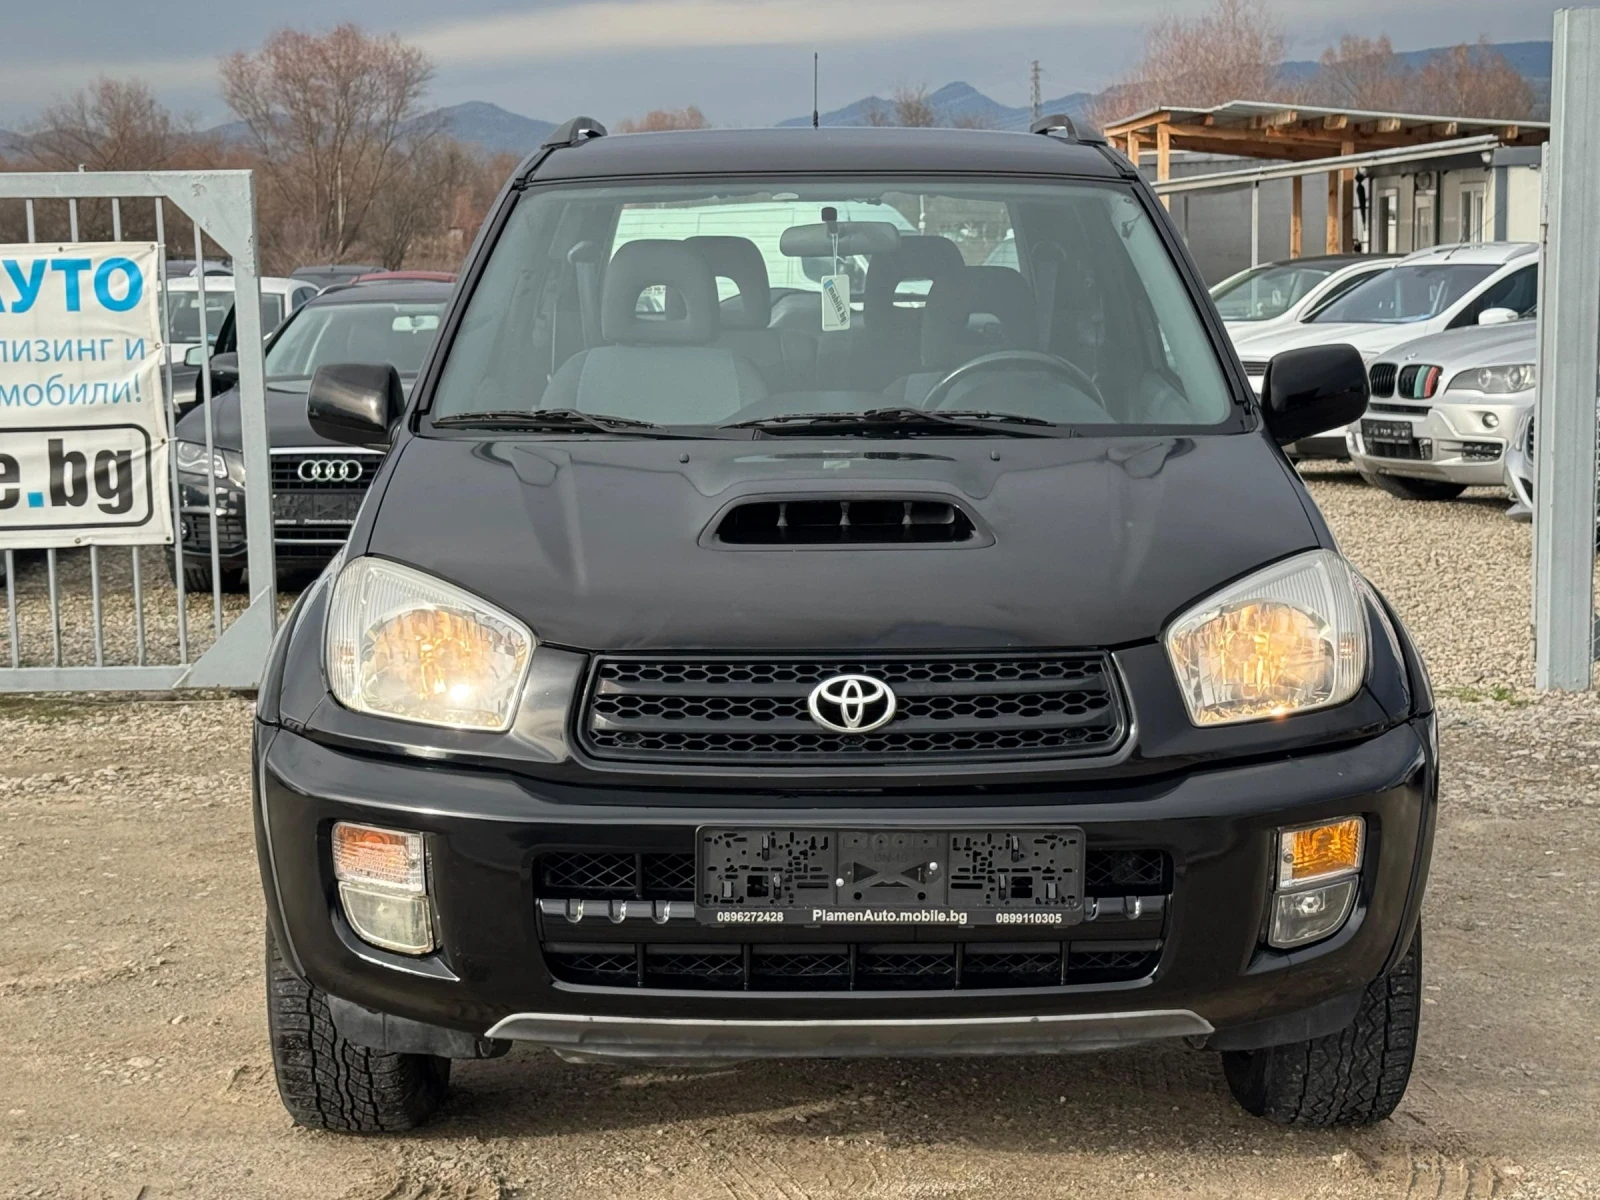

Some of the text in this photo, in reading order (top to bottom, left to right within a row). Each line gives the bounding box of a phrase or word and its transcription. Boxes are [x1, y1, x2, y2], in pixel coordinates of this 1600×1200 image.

[0, 257, 144, 313] УТО
[126, 338, 145, 361] и
[716, 909, 1062, 925] 0896272428 PlamenAuto.mobile.bg 0899110305
